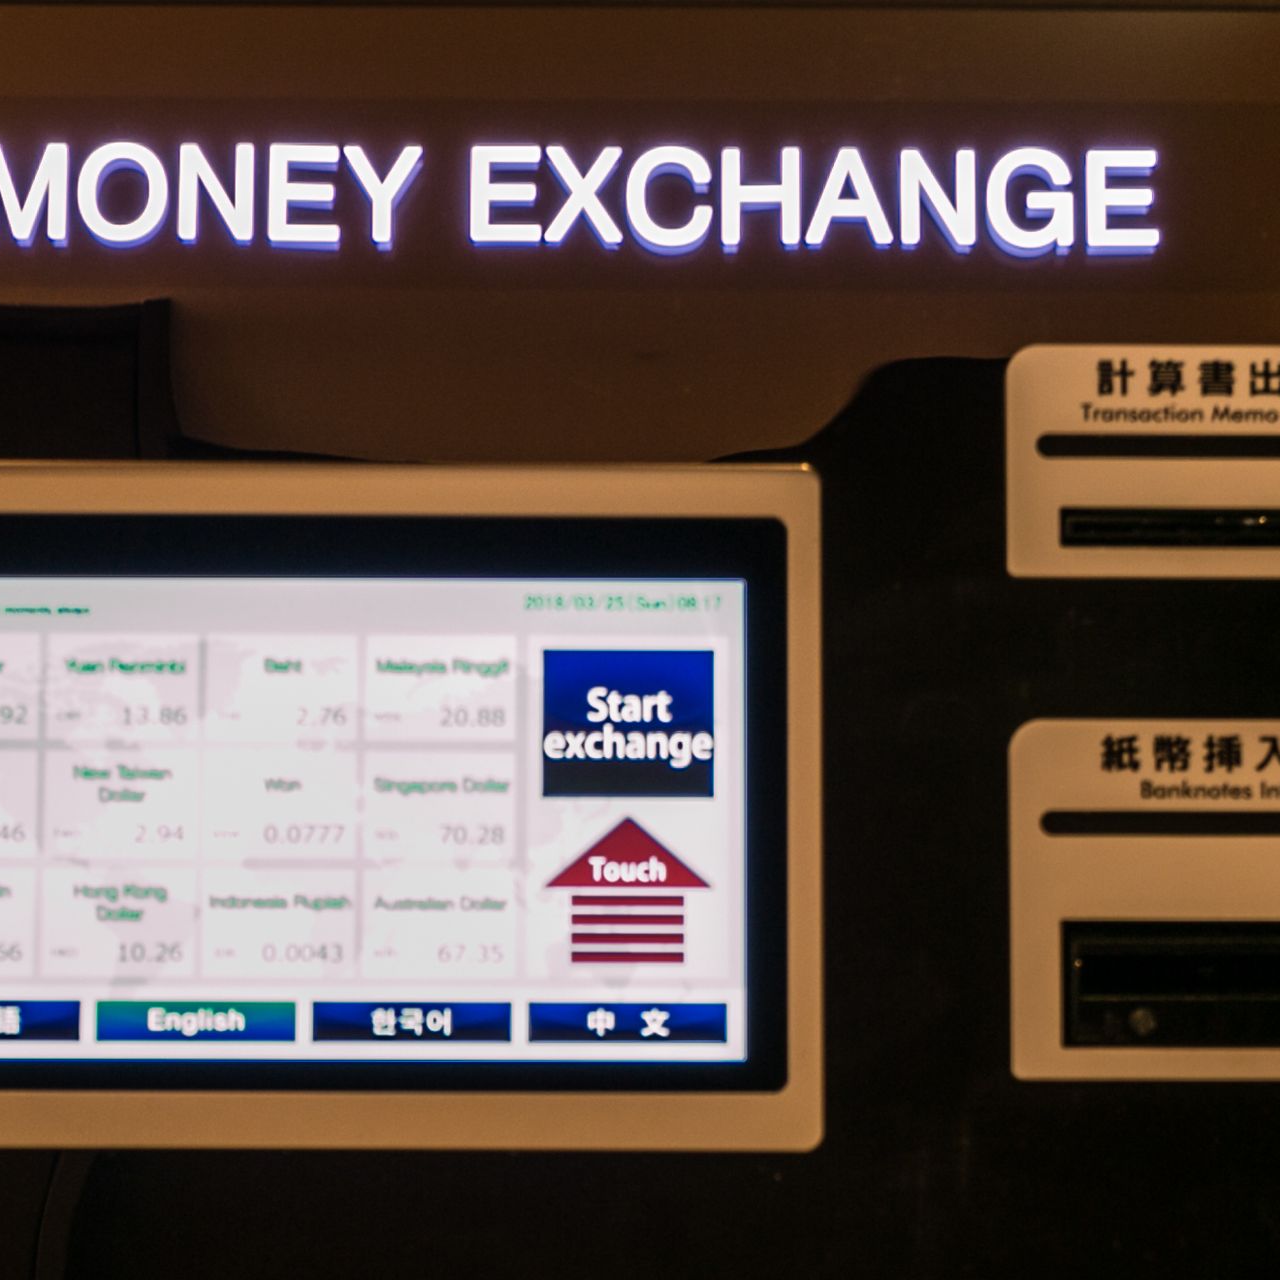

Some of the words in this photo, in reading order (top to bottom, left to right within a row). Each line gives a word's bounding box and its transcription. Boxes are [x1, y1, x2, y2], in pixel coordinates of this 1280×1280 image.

[468, 143, 1162, 258] EXCHANGE
[1081, 403, 1204, 423] Transaction
[1211, 404, 1279, 423] Memo
[586, 687, 673, 723] Start
[123, 706, 187, 725] 13.86
[297, 707, 347, 726] 2.76
[440, 707, 506, 727] 20.88
[543, 725, 714, 768] exchange
[1140, 780, 1253, 800] Banknotes
[134, 825, 185, 843] 2.94
[263, 825, 345, 844] 0.0777
[440, 826, 506, 845] 70.28
[588, 855, 668, 884] Touch
[119, 943, 184, 963] 10.26
[262, 944, 344, 963] 0.0043
[437, 944, 504, 964] 67.35
[146, 1007, 246, 1036] English
[371, 1007, 452, 1037] 한국어
